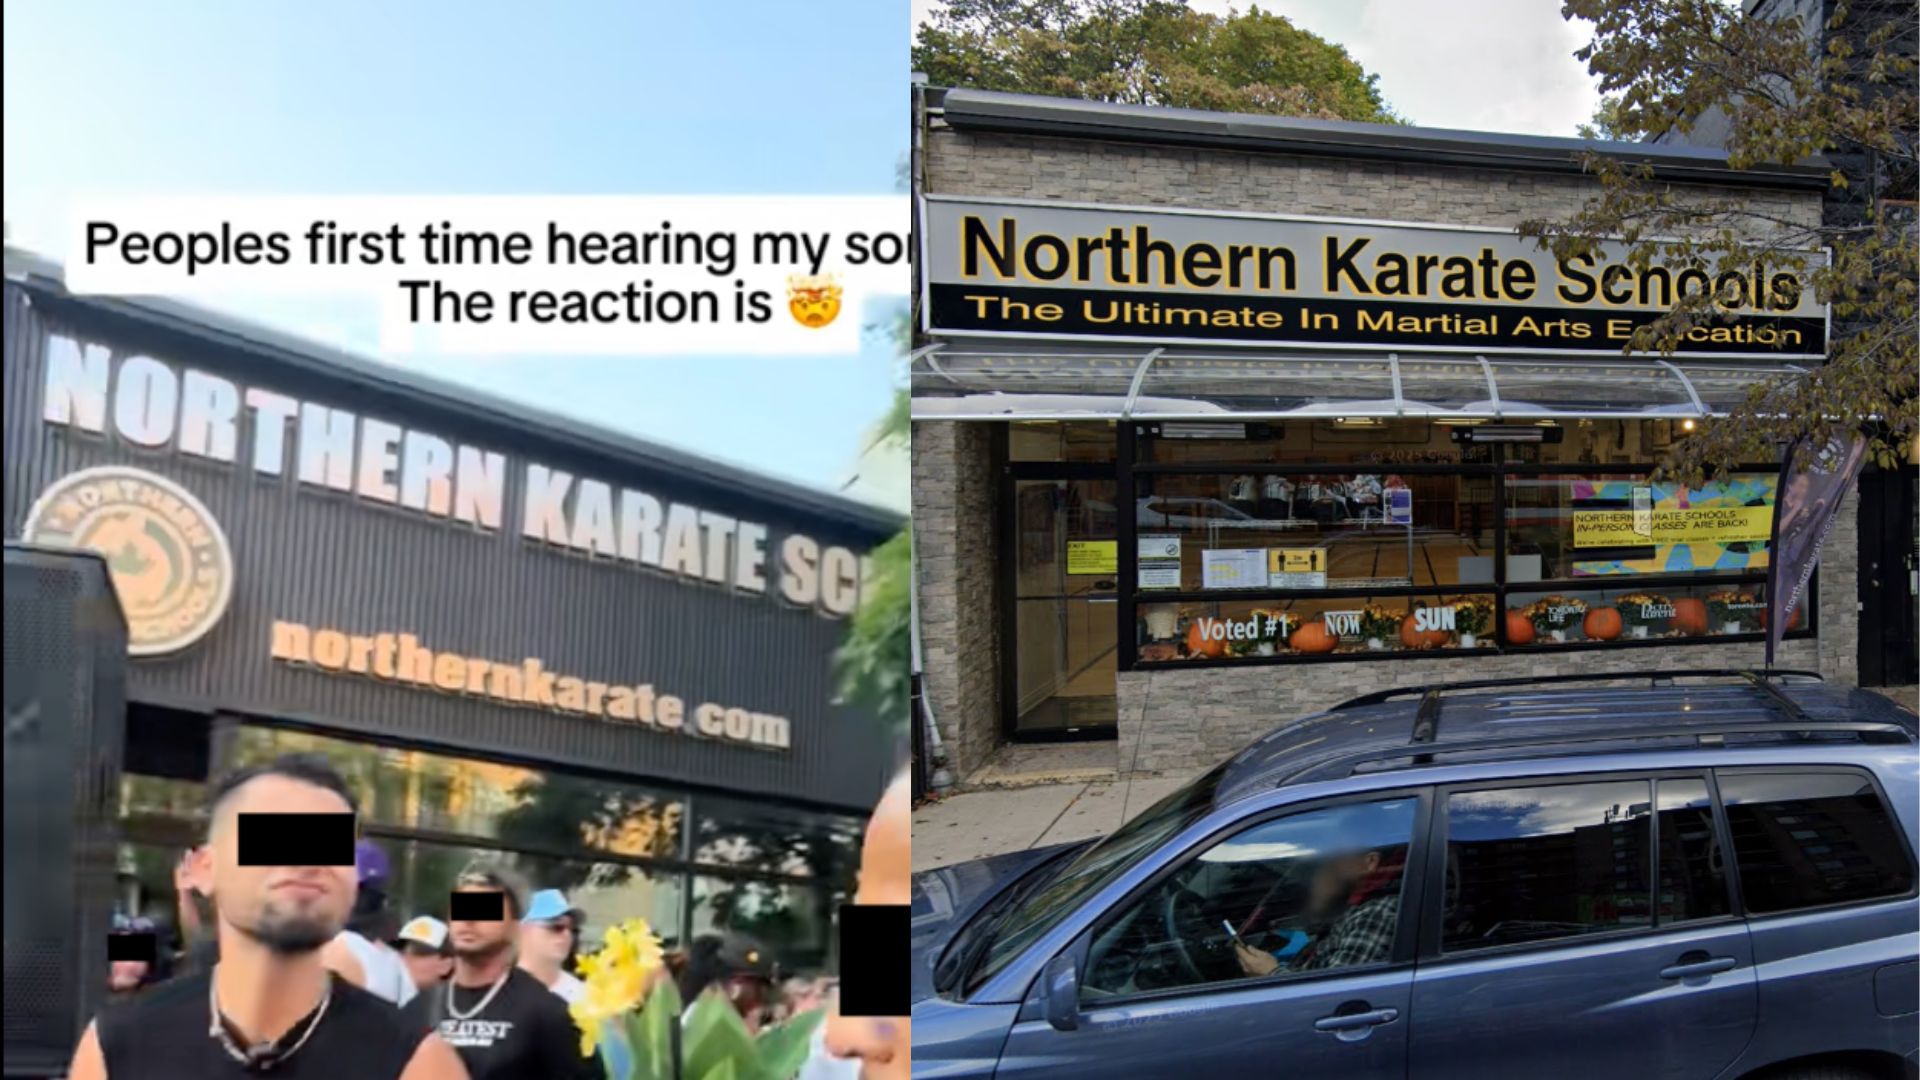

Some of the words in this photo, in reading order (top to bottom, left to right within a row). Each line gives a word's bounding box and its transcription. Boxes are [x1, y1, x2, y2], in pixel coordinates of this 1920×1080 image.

[961, 215, 1297, 292] Northern
[1323, 236, 1537, 301] Karate
[963, 295, 1064, 321] The
[1083, 299, 1284, 328] Ultimate
[1300, 307, 1339, 330] In
[1356, 309, 1498, 335] Martial
[1511, 315, 1592, 338] Arts
[1606, 319, 1803, 345] Ecation
[43, 336, 506, 531] NORTHERN
[522, 461, 769, 594] KARATE
[1575, 512, 1634, 523] NORTHERN
[1639, 511, 1682, 522] KARATE
[1685, 510, 1736, 520] SCHOOLS
[1576, 522, 1634, 533] IN-PERSON
[1693, 520, 1714, 529] ARE
[1717, 518, 1748, 529] BACK!
[1198, 613, 1259, 642] Voted
[1265, 613, 1288, 638] #1
[1324, 613, 1362, 637] NOW
[1414, 606, 1456, 632] SUN
[271, 619, 792, 749] northernkarate.com
